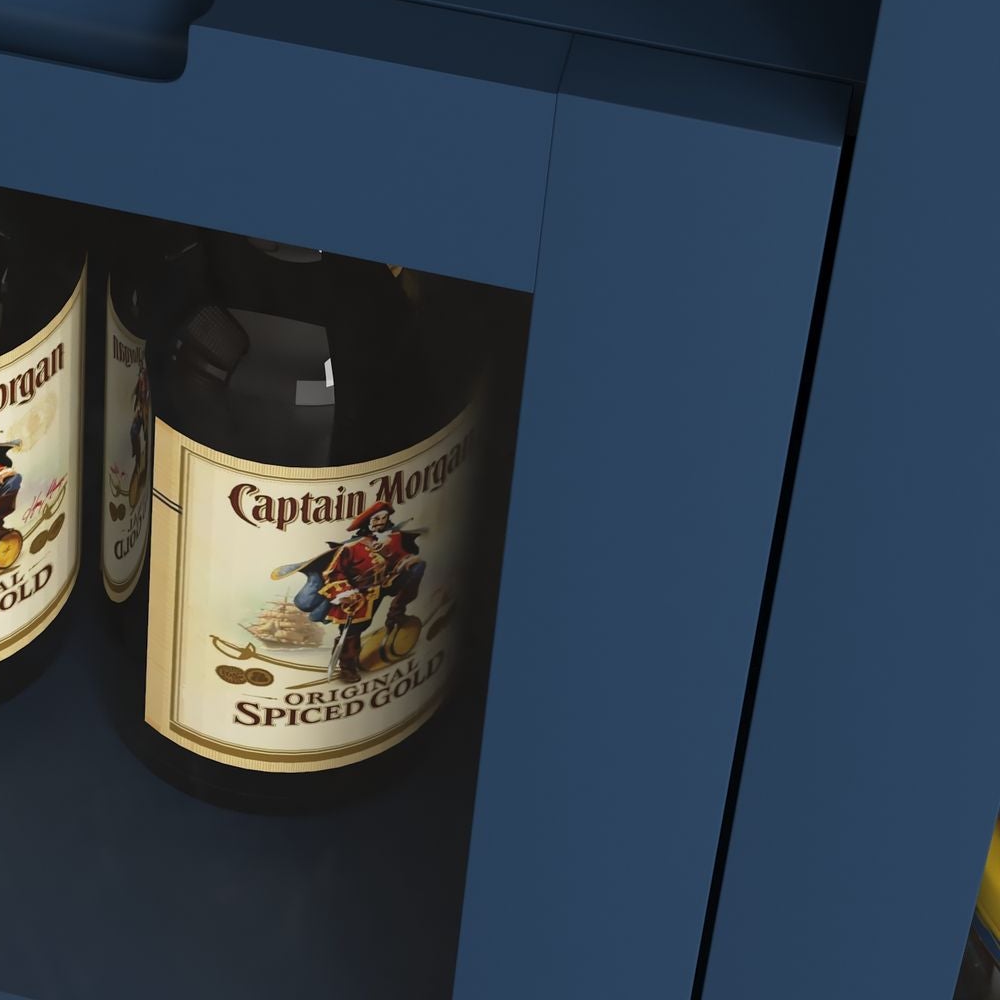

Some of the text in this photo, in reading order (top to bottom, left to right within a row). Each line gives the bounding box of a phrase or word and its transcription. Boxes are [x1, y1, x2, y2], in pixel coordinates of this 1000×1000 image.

[228, 483, 366, 531] Captain
[234, 650, 445, 727] SPICED GOLD
[284, 658, 419, 706] ORIGINAL
